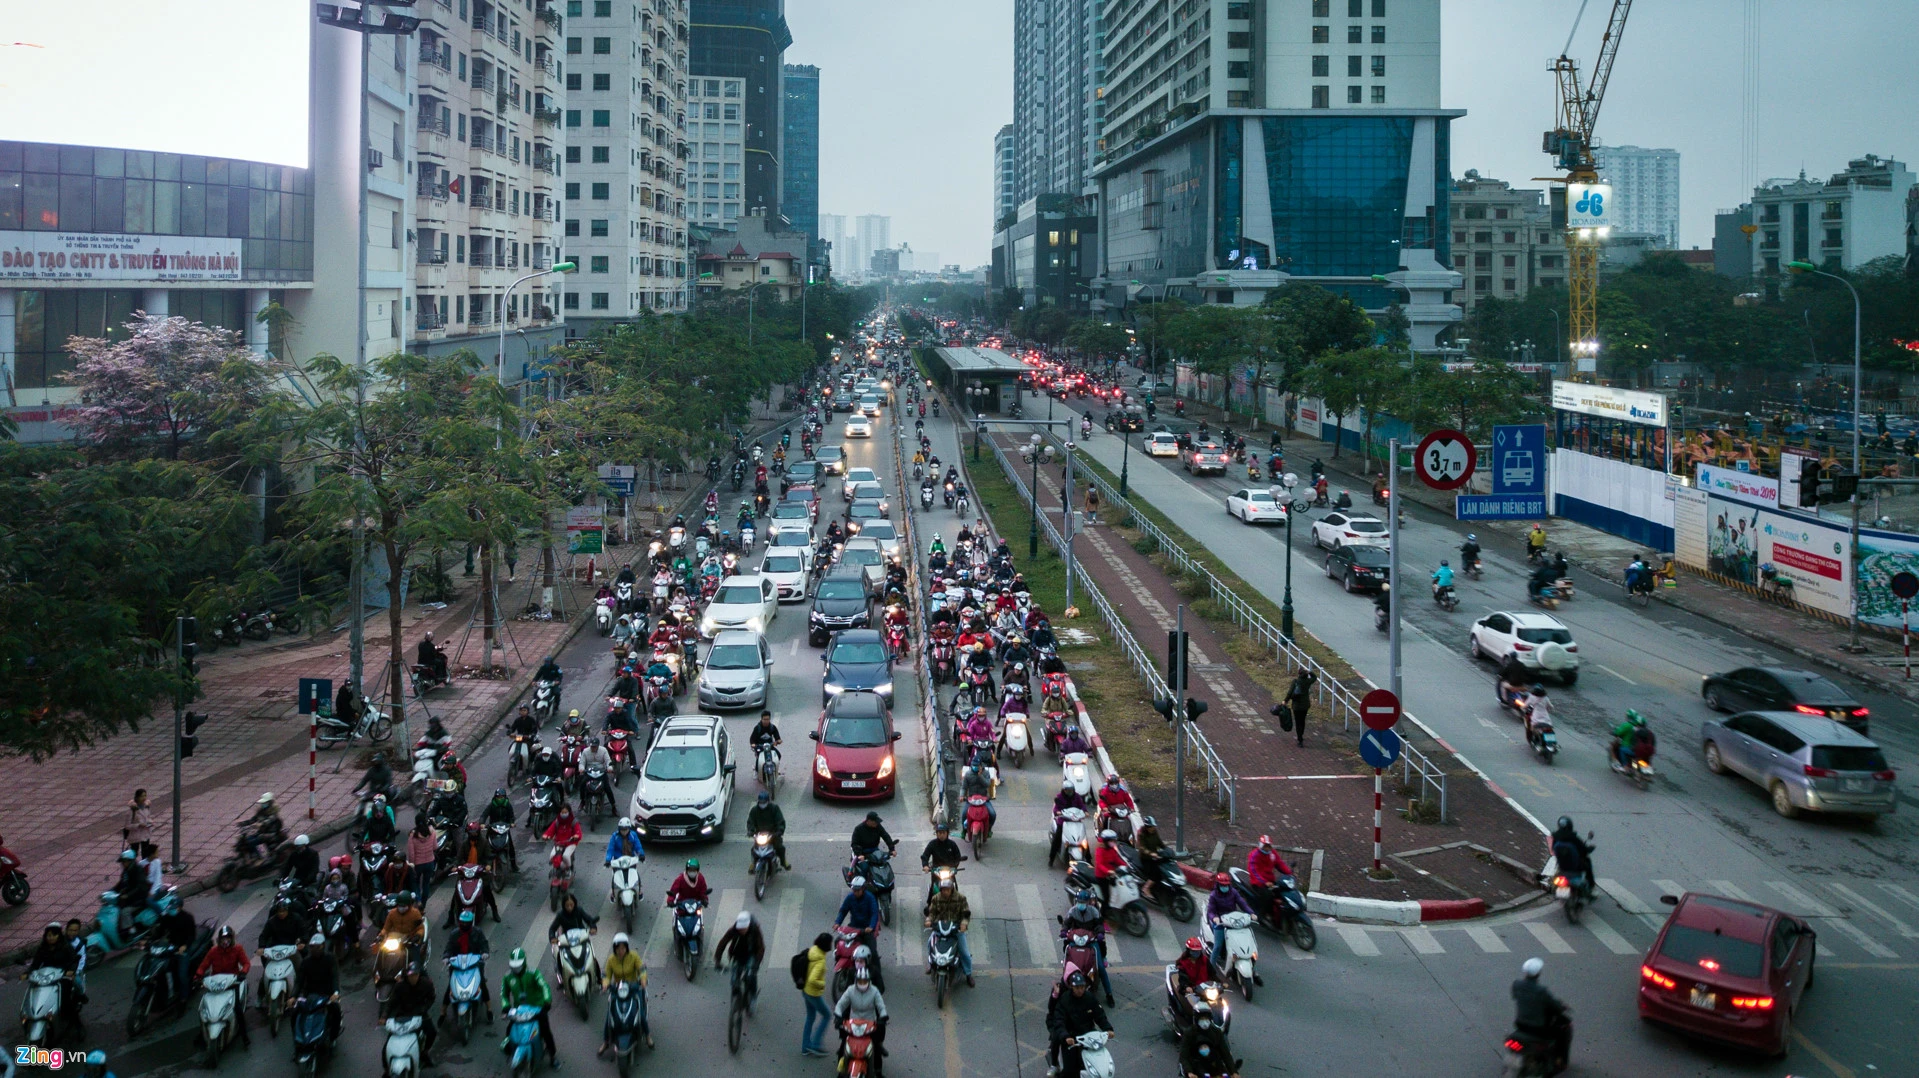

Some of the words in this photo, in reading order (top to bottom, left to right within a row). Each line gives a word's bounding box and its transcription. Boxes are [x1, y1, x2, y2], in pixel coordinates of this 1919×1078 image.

[2, 246, 34, 267] ĐÀO
[38, 252, 66, 271] TẠO
[70, 253, 106, 269] CNTT
[109, 253, 119, 269] &
[121, 248, 167, 270] TRUYỀN
[169, 250, 206, 270] THÔNG
[208, 252, 222, 270] HÀ
[223, 251, 239, 273] NỘI
[1430, 450, 1449, 474] 3,7
[1453, 461, 1460, 471] m
[611, 467, 621, 476] ila
[1760, 486, 1776, 500] 2019
[1462, 499, 1477, 514] LÀN
[1480, 500, 1499, 514] DÀNH
[1502, 499, 1525, 514] RIÊNG
[1528, 502, 1542, 514] BRT
[1774, 545, 1786, 555] CÔNG
